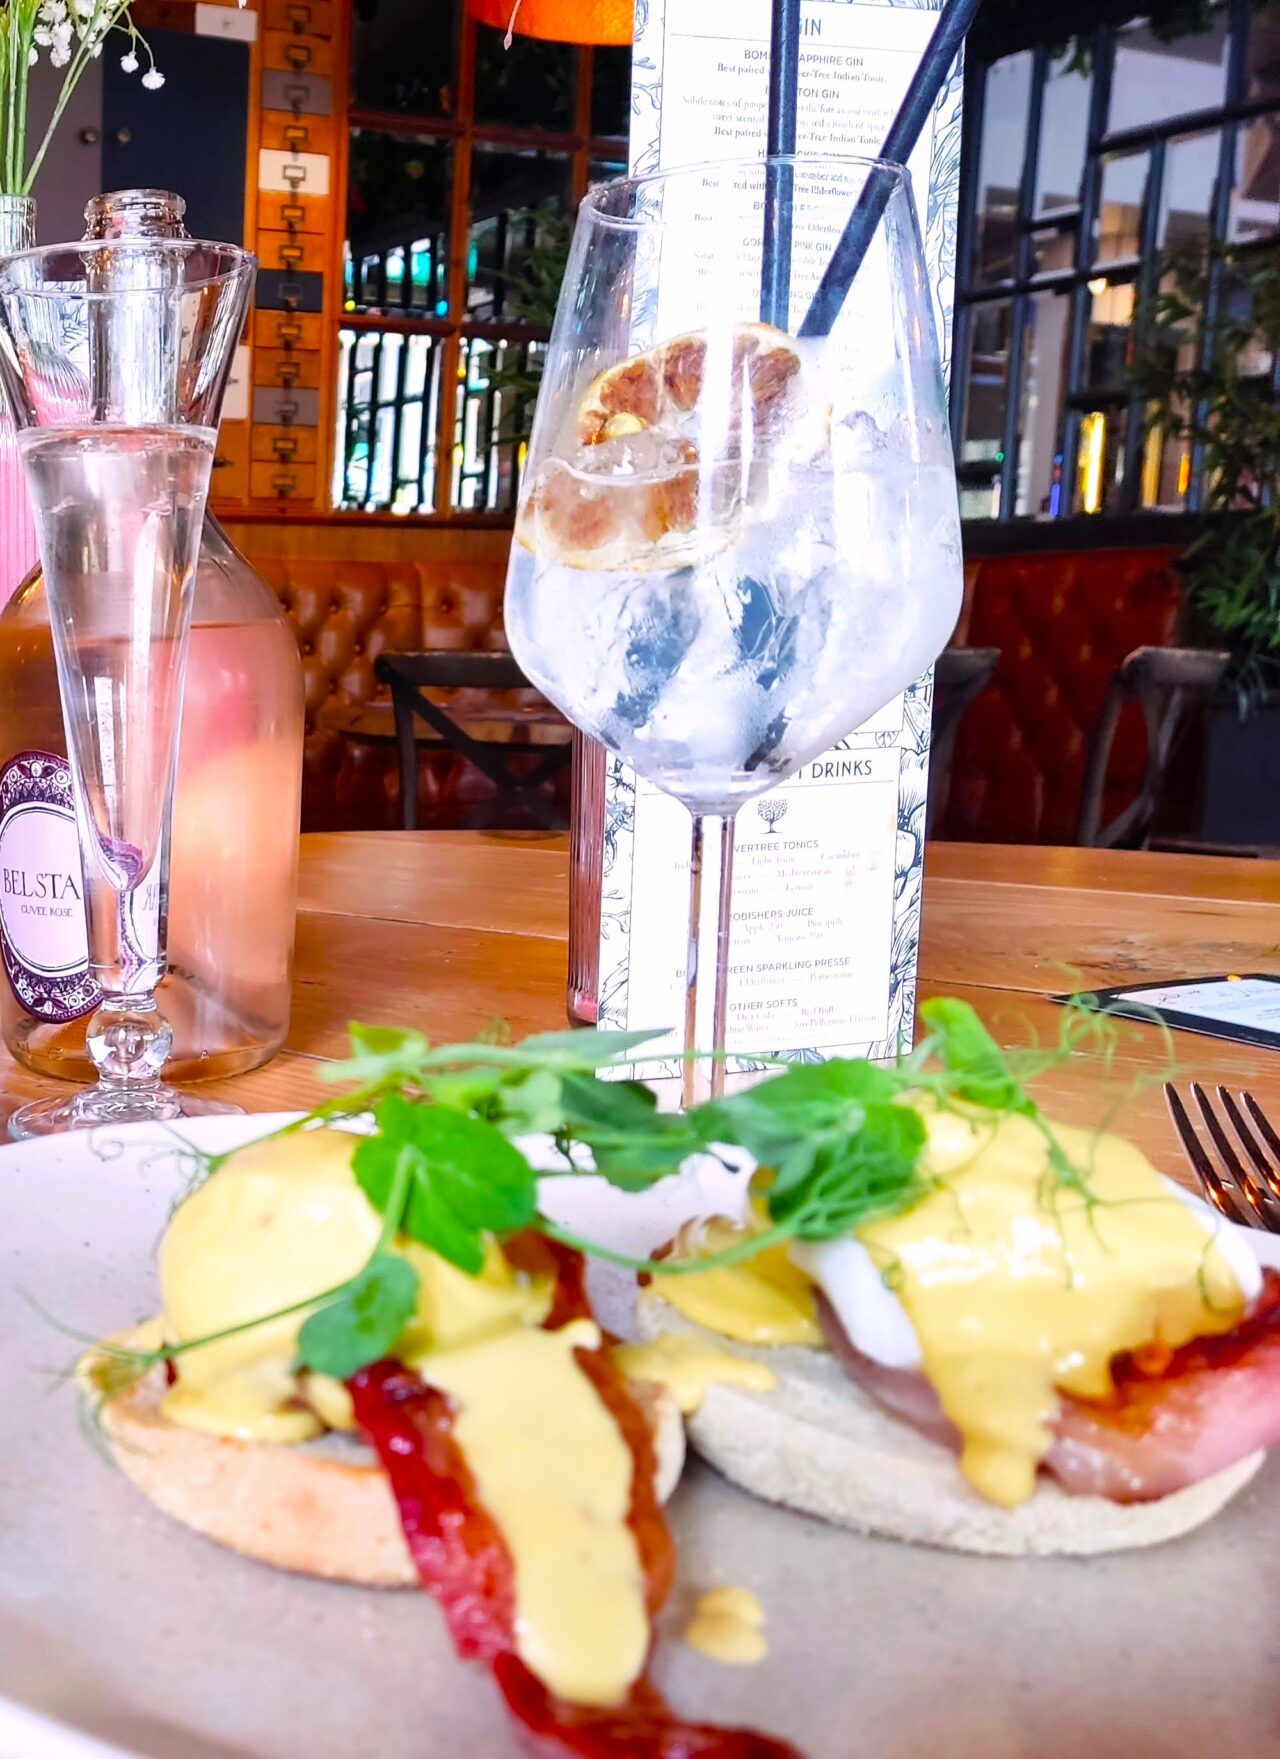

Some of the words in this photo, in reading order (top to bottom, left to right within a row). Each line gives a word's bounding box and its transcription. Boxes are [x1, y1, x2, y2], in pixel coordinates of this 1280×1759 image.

[799, 53, 842, 66] APPHIRE
[846, 56, 864, 67] GIN
[717, 62, 736, 72] Best
[738, 64, 765, 76] paired
[833, 71, 860, 81] Indian
[821, 88, 840, 99] GIN
[713, 126, 733, 135] Best
[735, 128, 762, 139] paired
[829, 133, 856, 144] Indian
[815, 242, 832, 252] GIN
[811, 759, 873, 779] DRINKS
[734, 842, 780, 853] VERTREE
[783, 839, 819, 851] TONICS
[3, 867, 82, 901] BELSTA
[732, 909, 783, 921] OBISHERS
[786, 907, 814, 918] JUICE
[756, 960, 812, 973] SPARKLING
[814, 956, 851, 968] PRESSE
[729, 1001, 764, 1012] OTHER
[766, 998, 798, 1009] SOFTS
